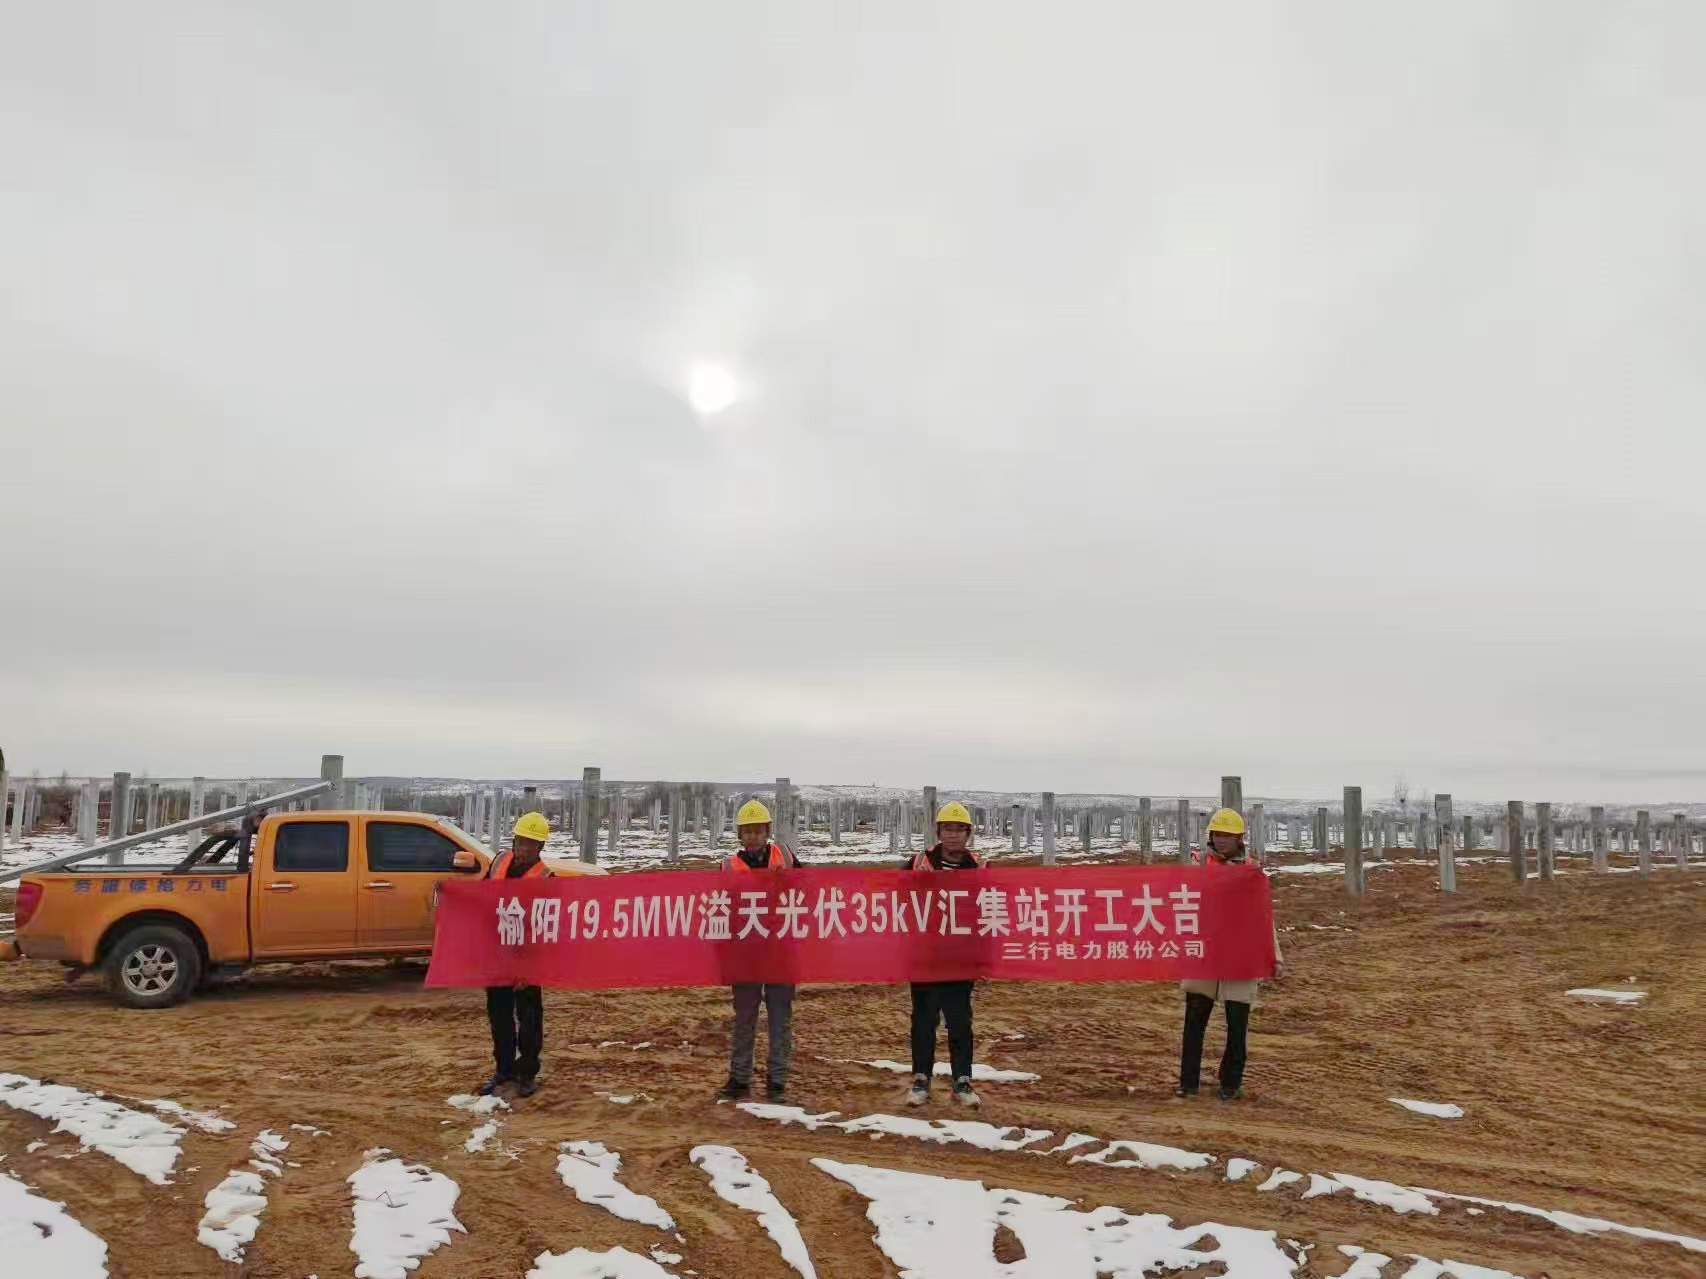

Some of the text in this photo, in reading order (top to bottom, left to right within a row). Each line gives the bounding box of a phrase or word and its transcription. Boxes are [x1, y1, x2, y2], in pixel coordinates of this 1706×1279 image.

[496, 883, 1202, 946] 榆阳19.5MW溢天光伏35kV汇集站开工大吉
[1002, 939, 1206, 962] 三行电力股份公司
